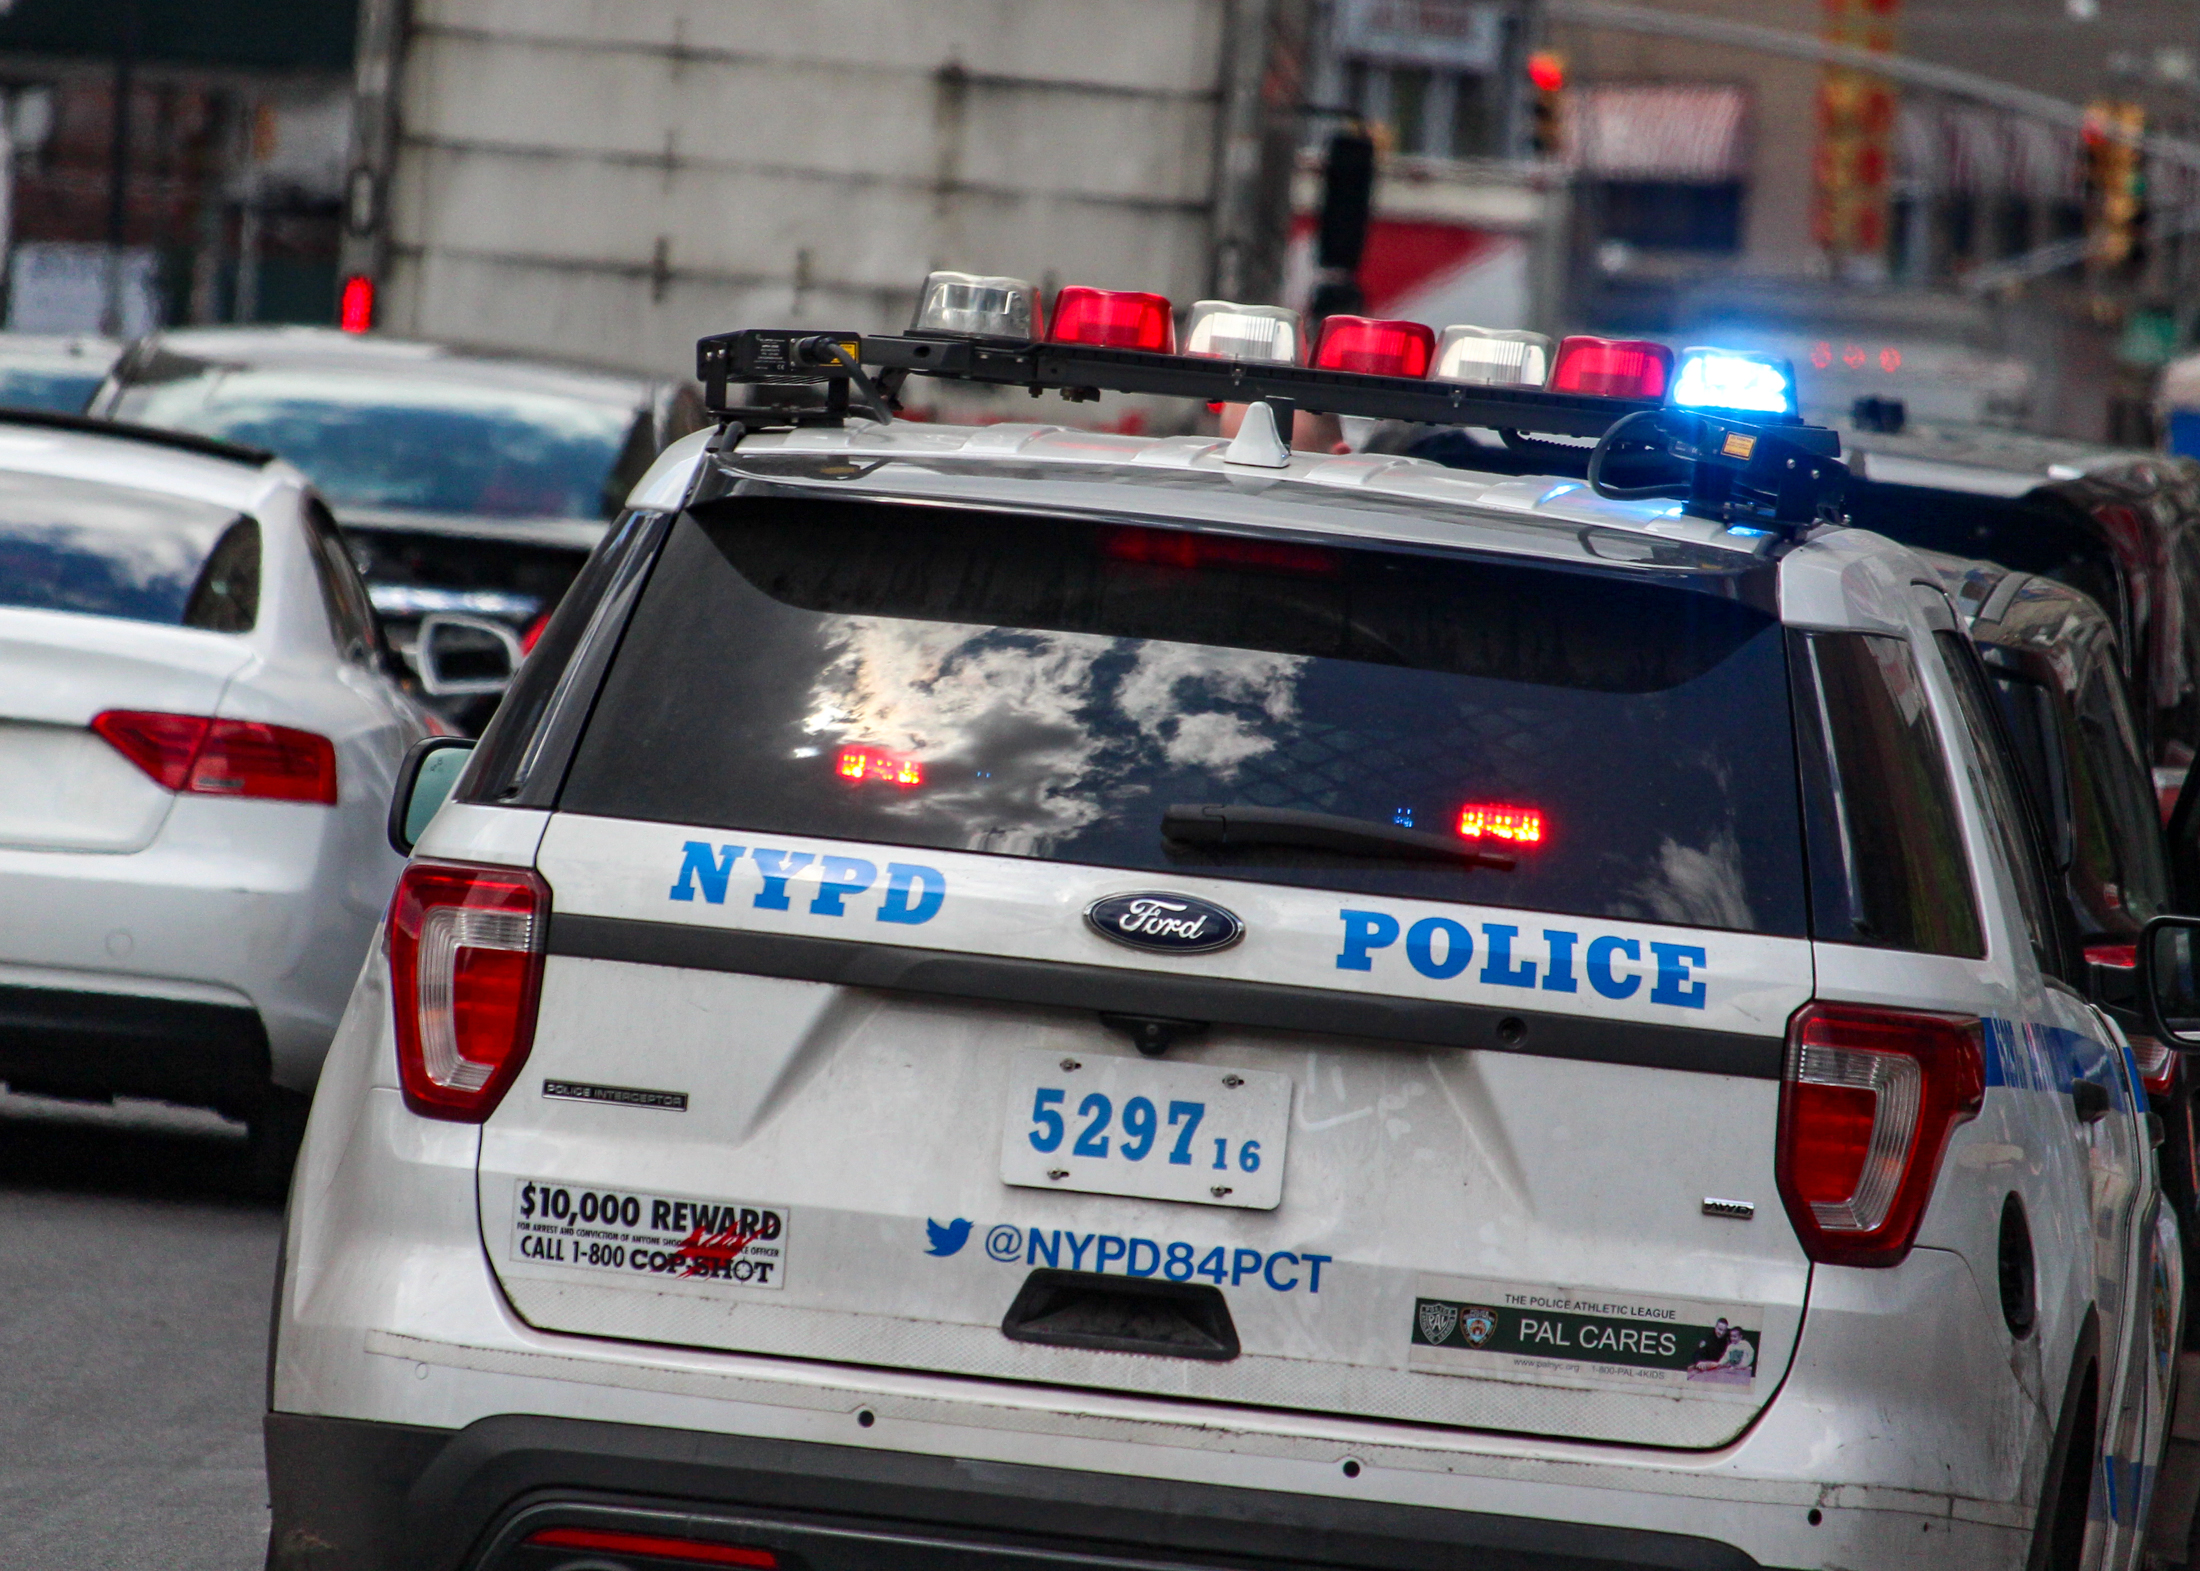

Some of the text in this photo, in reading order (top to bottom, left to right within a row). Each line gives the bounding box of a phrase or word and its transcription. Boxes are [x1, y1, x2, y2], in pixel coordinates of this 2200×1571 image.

[669, 841, 947, 926] NYPD
[1119, 899, 1208, 940] Ford
[1336, 909, 1707, 1010] POLICE
[547, 1083, 683, 1107] POLICE INTERCEPTOR
[1028, 1088, 1262, 1174] 5297 16
[520, 1181, 781, 1240] $10,000 REWARD
[1703, 1202, 1754, 1216] AWD
[517, 1221, 530, 1231] FOR
[532, 1223, 559, 1236] ARREST
[560, 1227, 575, 1237] AND
[576, 1228, 619, 1242] CONVICTION
[621, 1233, 629, 1242] OF
[631, 1235, 660, 1246] ANYONE
[750, 1246, 780, 1257] OFFICER
[521, 1235, 565, 1262] CALL
[573, 1241, 625, 1268] 1-800
[985, 1224, 1333, 1293] @NYPD84PCT
[1429, 1314, 1447, 1331] PAL
[1505, 1293, 1677, 1320] THE POLICE ATHLETIC LEAGUE
[1519, 1318, 1571, 1346] PAL
[1579, 1325, 1677, 1357] CARES
